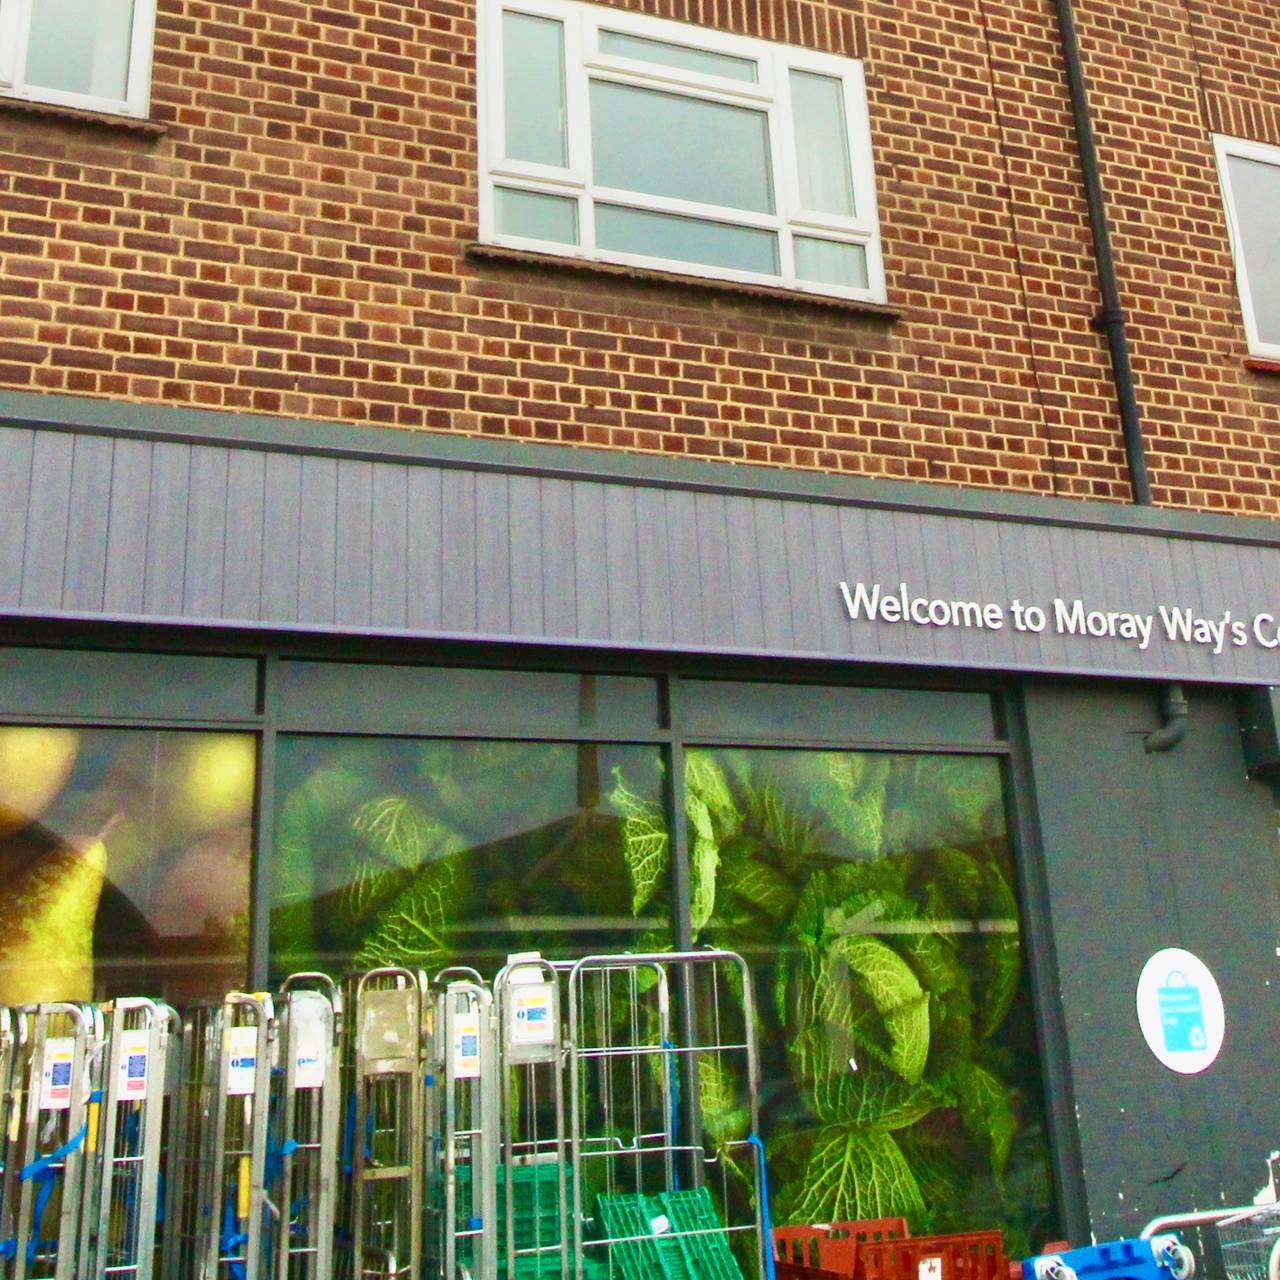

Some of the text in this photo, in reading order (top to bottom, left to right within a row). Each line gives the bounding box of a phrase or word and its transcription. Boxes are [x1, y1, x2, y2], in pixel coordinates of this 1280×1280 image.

[839, 581, 1003, 630] Welcome
[1010, 599, 1046, 632] to
[1054, 598, 1152, 650] Moray
[1158, 606, 1248, 655] Way's
